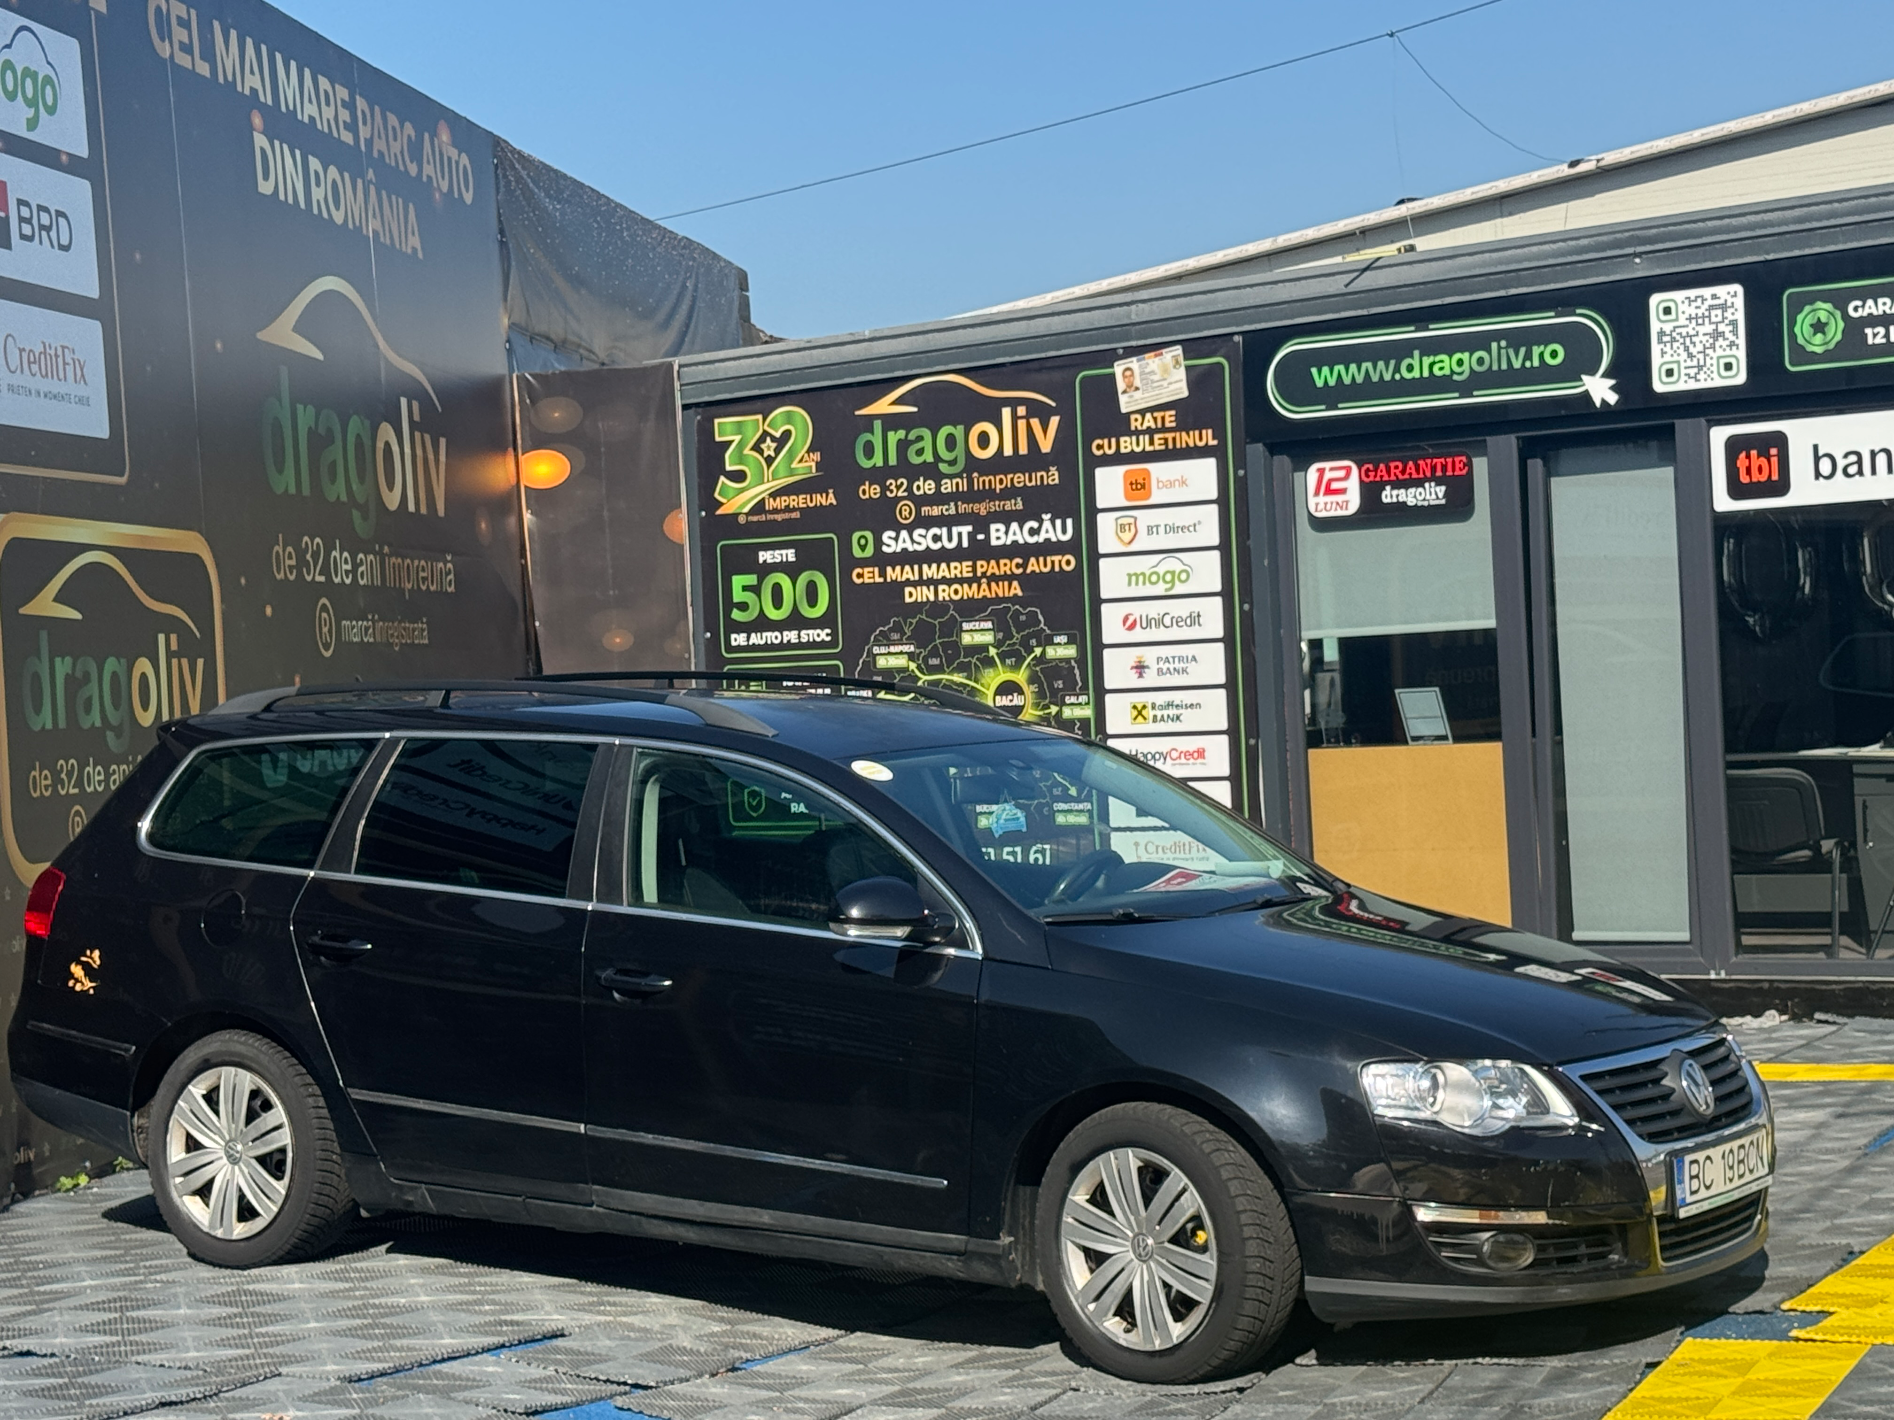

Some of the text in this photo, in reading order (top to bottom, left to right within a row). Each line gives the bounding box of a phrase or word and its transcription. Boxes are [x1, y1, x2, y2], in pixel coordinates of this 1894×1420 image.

[0, 58, 59, 132] ogo
[148, 0, 473, 206] CEL MAI MARE PARC AUTO
[253, 131, 423, 260] DIN ROMÂNIA
[16, 198, 73, 252] BRD
[1847, 297, 1894, 318] GAR
[1864, 326, 1886, 345] 12
[3, 333, 88, 386] CreditFix
[1310, 340, 1565, 388] www.dragoliv.ro
[1130, 410, 1176, 430] RATE
[262, 365, 447, 539] dragoliv
[855, 405, 1061, 474] dragoliv
[1091, 429, 1218, 455] CU BULETINUL
[714, 405, 820, 503] 32 ANI
[1736, 443, 1894, 483] tbi ban
[858, 466, 1060, 499] de 32 de ani împreună
[1313, 466, 1352, 497] 12
[1361, 456, 1469, 482] GARANTIE
[1129, 475, 1188, 492] tbi bank
[1381, 482, 1447, 505] dragoliv
[920, 503, 956, 517] marcă
[957, 497, 1023, 515] înregistrată
[1314, 501, 1350, 512] LUNI
[881, 525, 973, 553] SASCUT
[989, 513, 1074, 547] BACĂU
[1119, 523, 1132, 533] BT
[1146, 525, 1161, 536] BT
[273, 534, 455, 600] de 32 de ani împreună
[758, 549, 796, 564] PESTE
[852, 554, 1076, 584] CEL MAI MARE PARC AUTO
[904, 578, 1023, 603] DIN ROMÂNIA
[1126, 569, 1190, 592] mogo
[731, 570, 830, 622] 500
[341, 613, 374, 643] marcă
[375, 614, 429, 651] înregistrată
[1140, 611, 1202, 630] UniCredit
[730, 628, 832, 646] DE AUTO PE STOC
[1156, 655, 1198, 665] PATRIA
[1157, 666, 1189, 676] BANK
[22, 630, 204, 753] dragoliv
[1151, 701, 1201, 711] Raiffeisen
[1152, 713, 1183, 723] BANK
[29, 762, 51, 798] de
[57, 759, 79, 795] 32
[84, 757, 104, 792] de
[1689, 1155, 1714, 1197] BC
